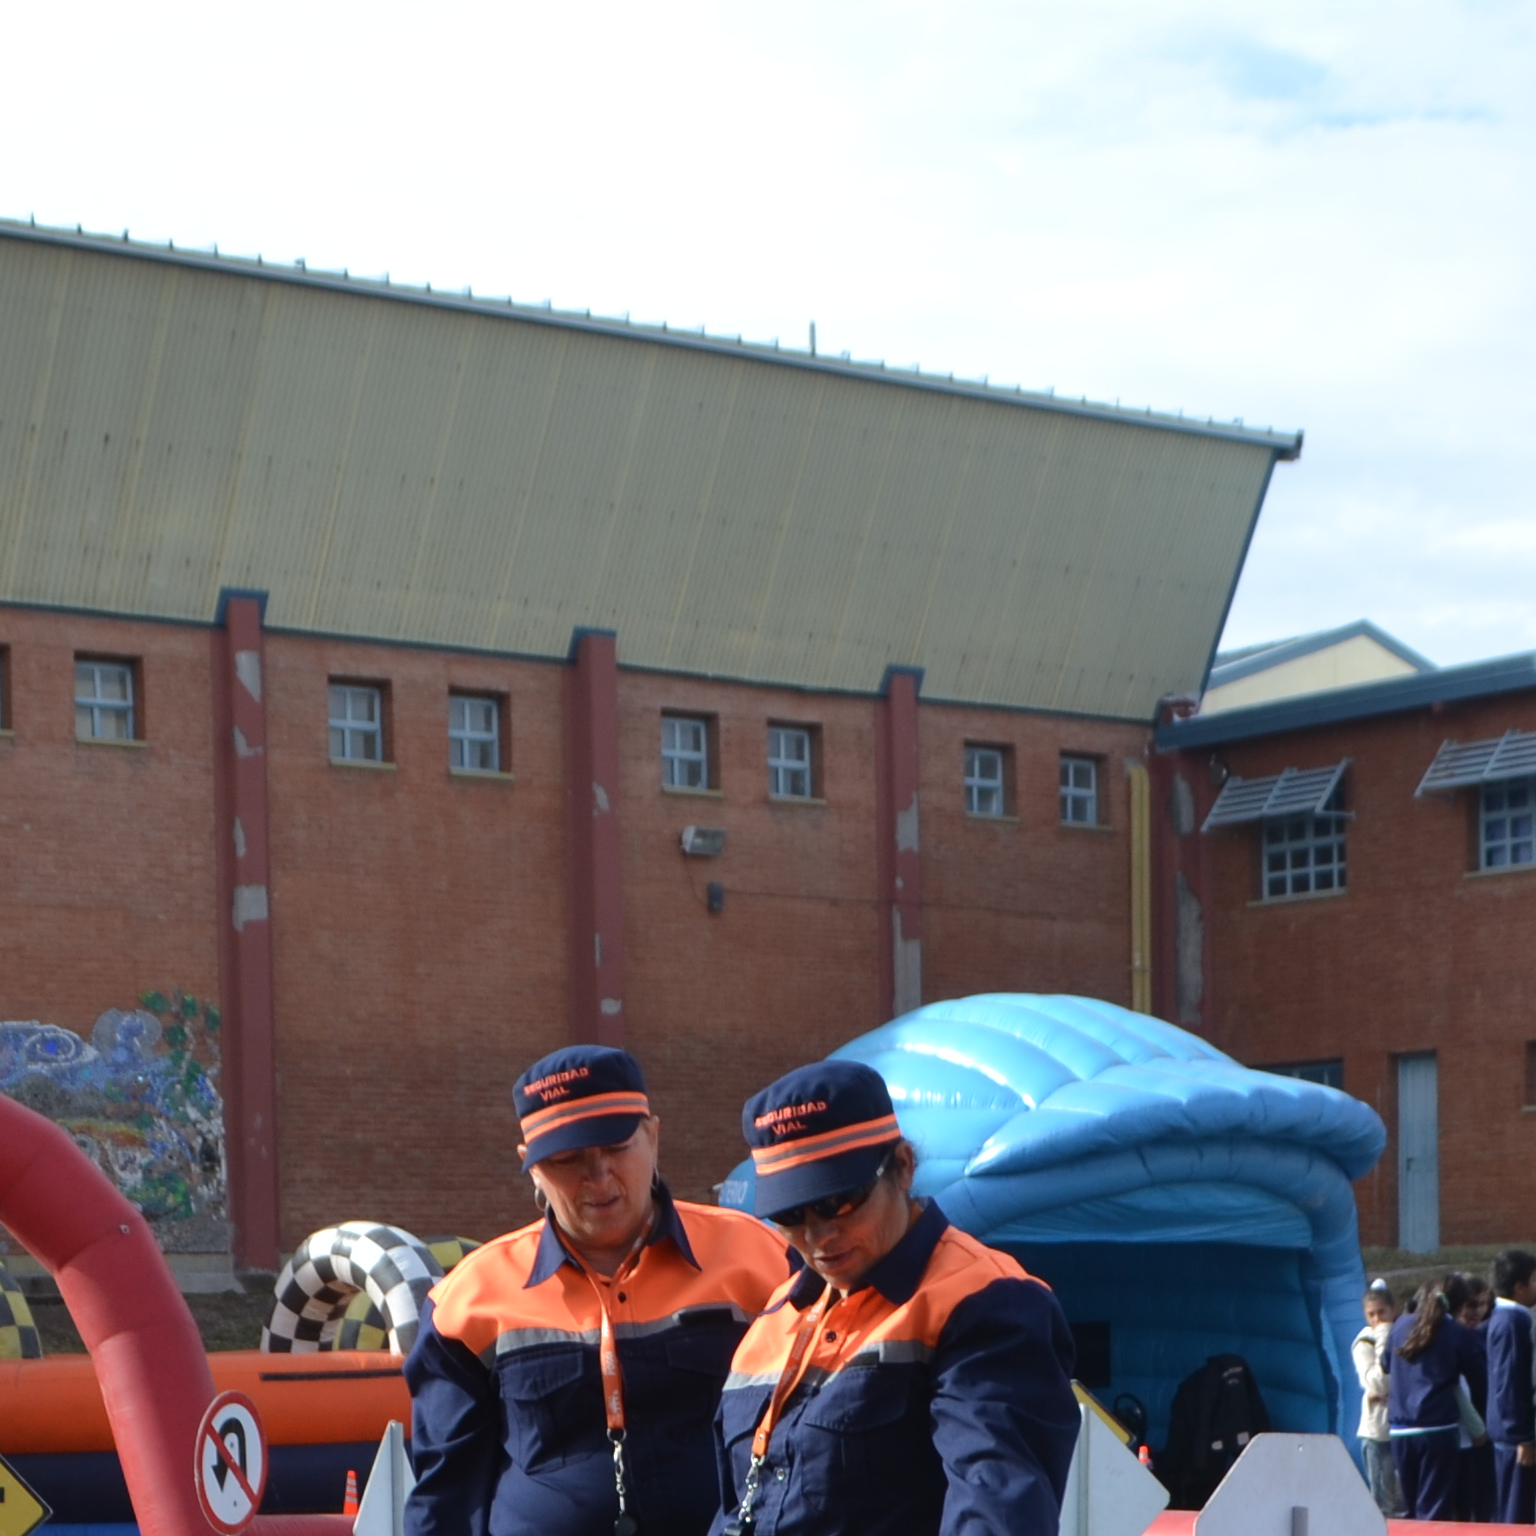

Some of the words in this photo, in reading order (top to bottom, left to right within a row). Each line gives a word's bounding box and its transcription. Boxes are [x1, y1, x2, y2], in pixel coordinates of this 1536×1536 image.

[523, 1066, 590, 1097] SEGURIDAD
[539, 1087, 570, 1102] VIAL
[754, 1100, 827, 1129] SEGURIDAD
[771, 1120, 807, 1136] VIAL
